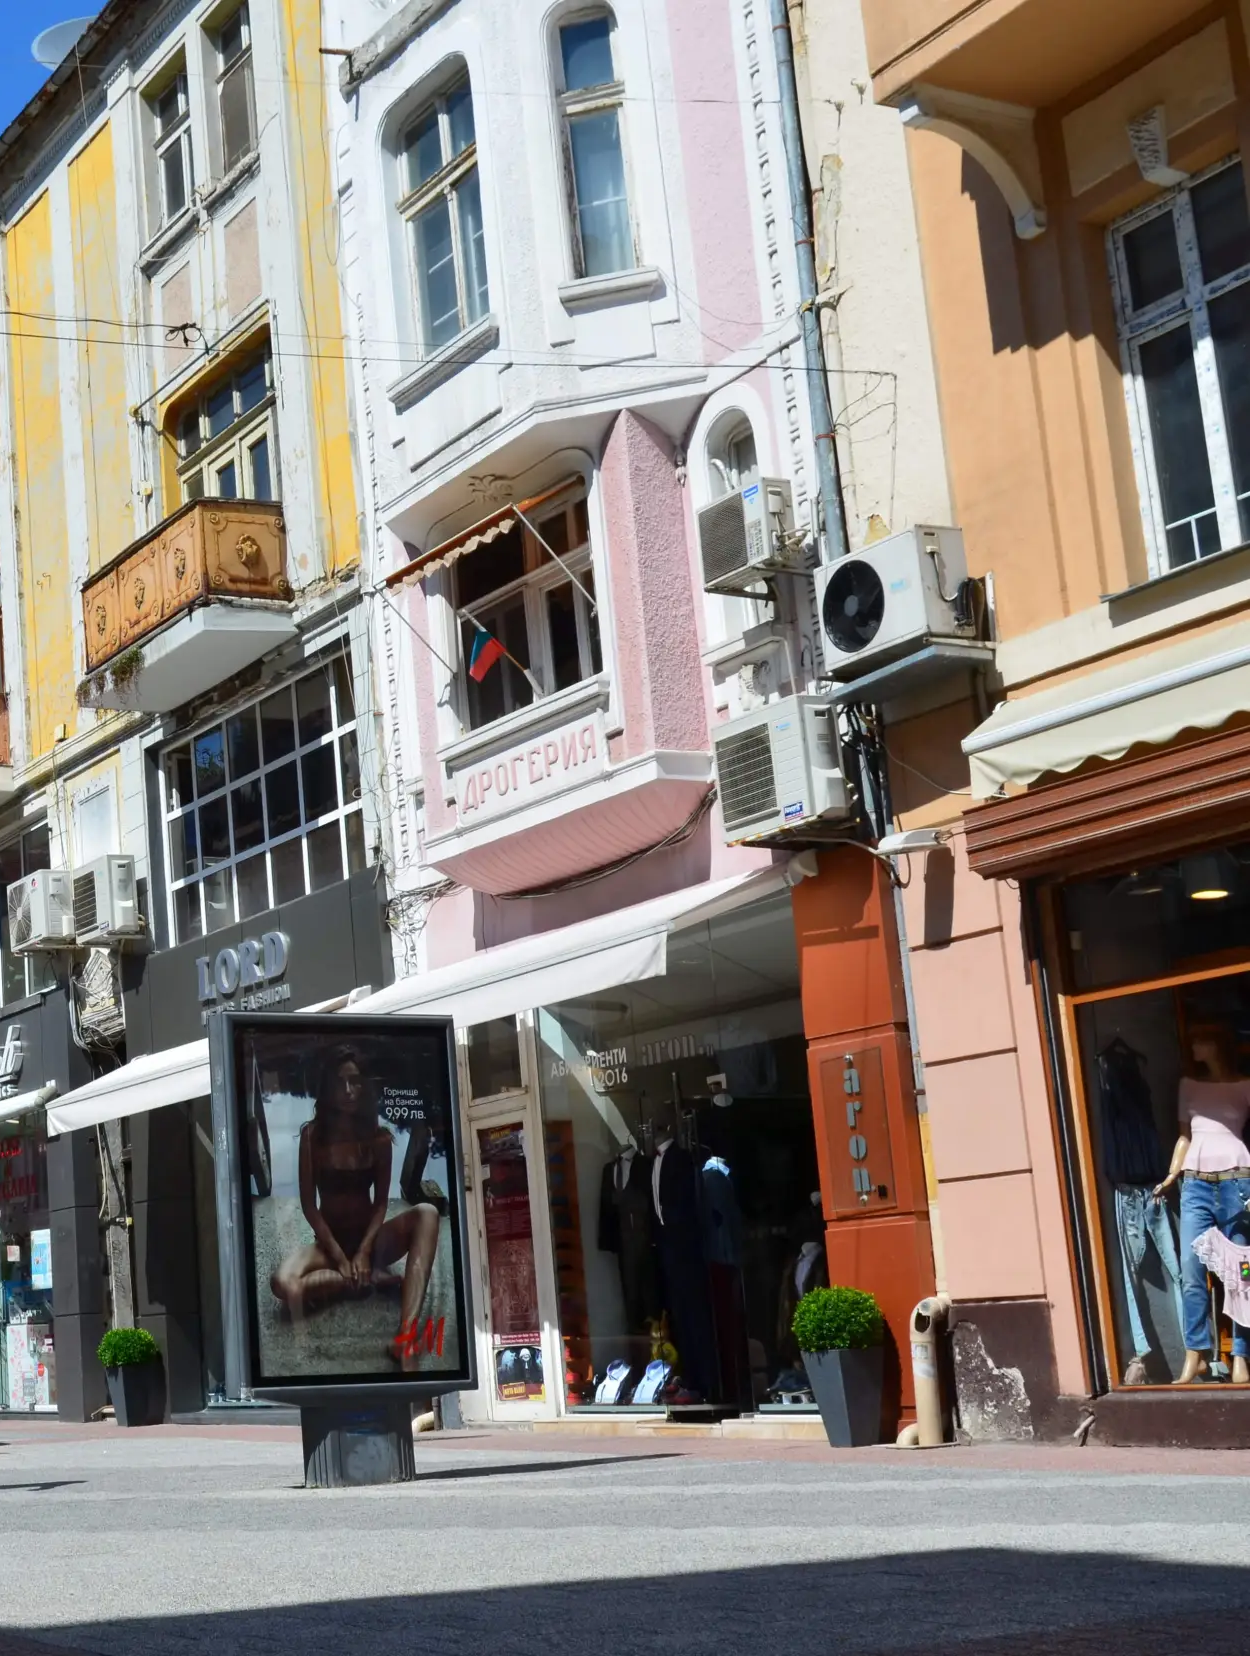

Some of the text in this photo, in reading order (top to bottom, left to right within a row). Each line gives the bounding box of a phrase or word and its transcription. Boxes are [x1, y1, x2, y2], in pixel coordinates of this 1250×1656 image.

[462, 724, 597, 815] ДРОГЕРИЯ
[195, 931, 289, 1001] LORD
[598, 1067, 628, 1088] 2016
[383, 1086, 419, 1097] Горнище
[395, 1097, 423, 1106] бански
[385, 1107, 427, 1121] 9,99 лв.
